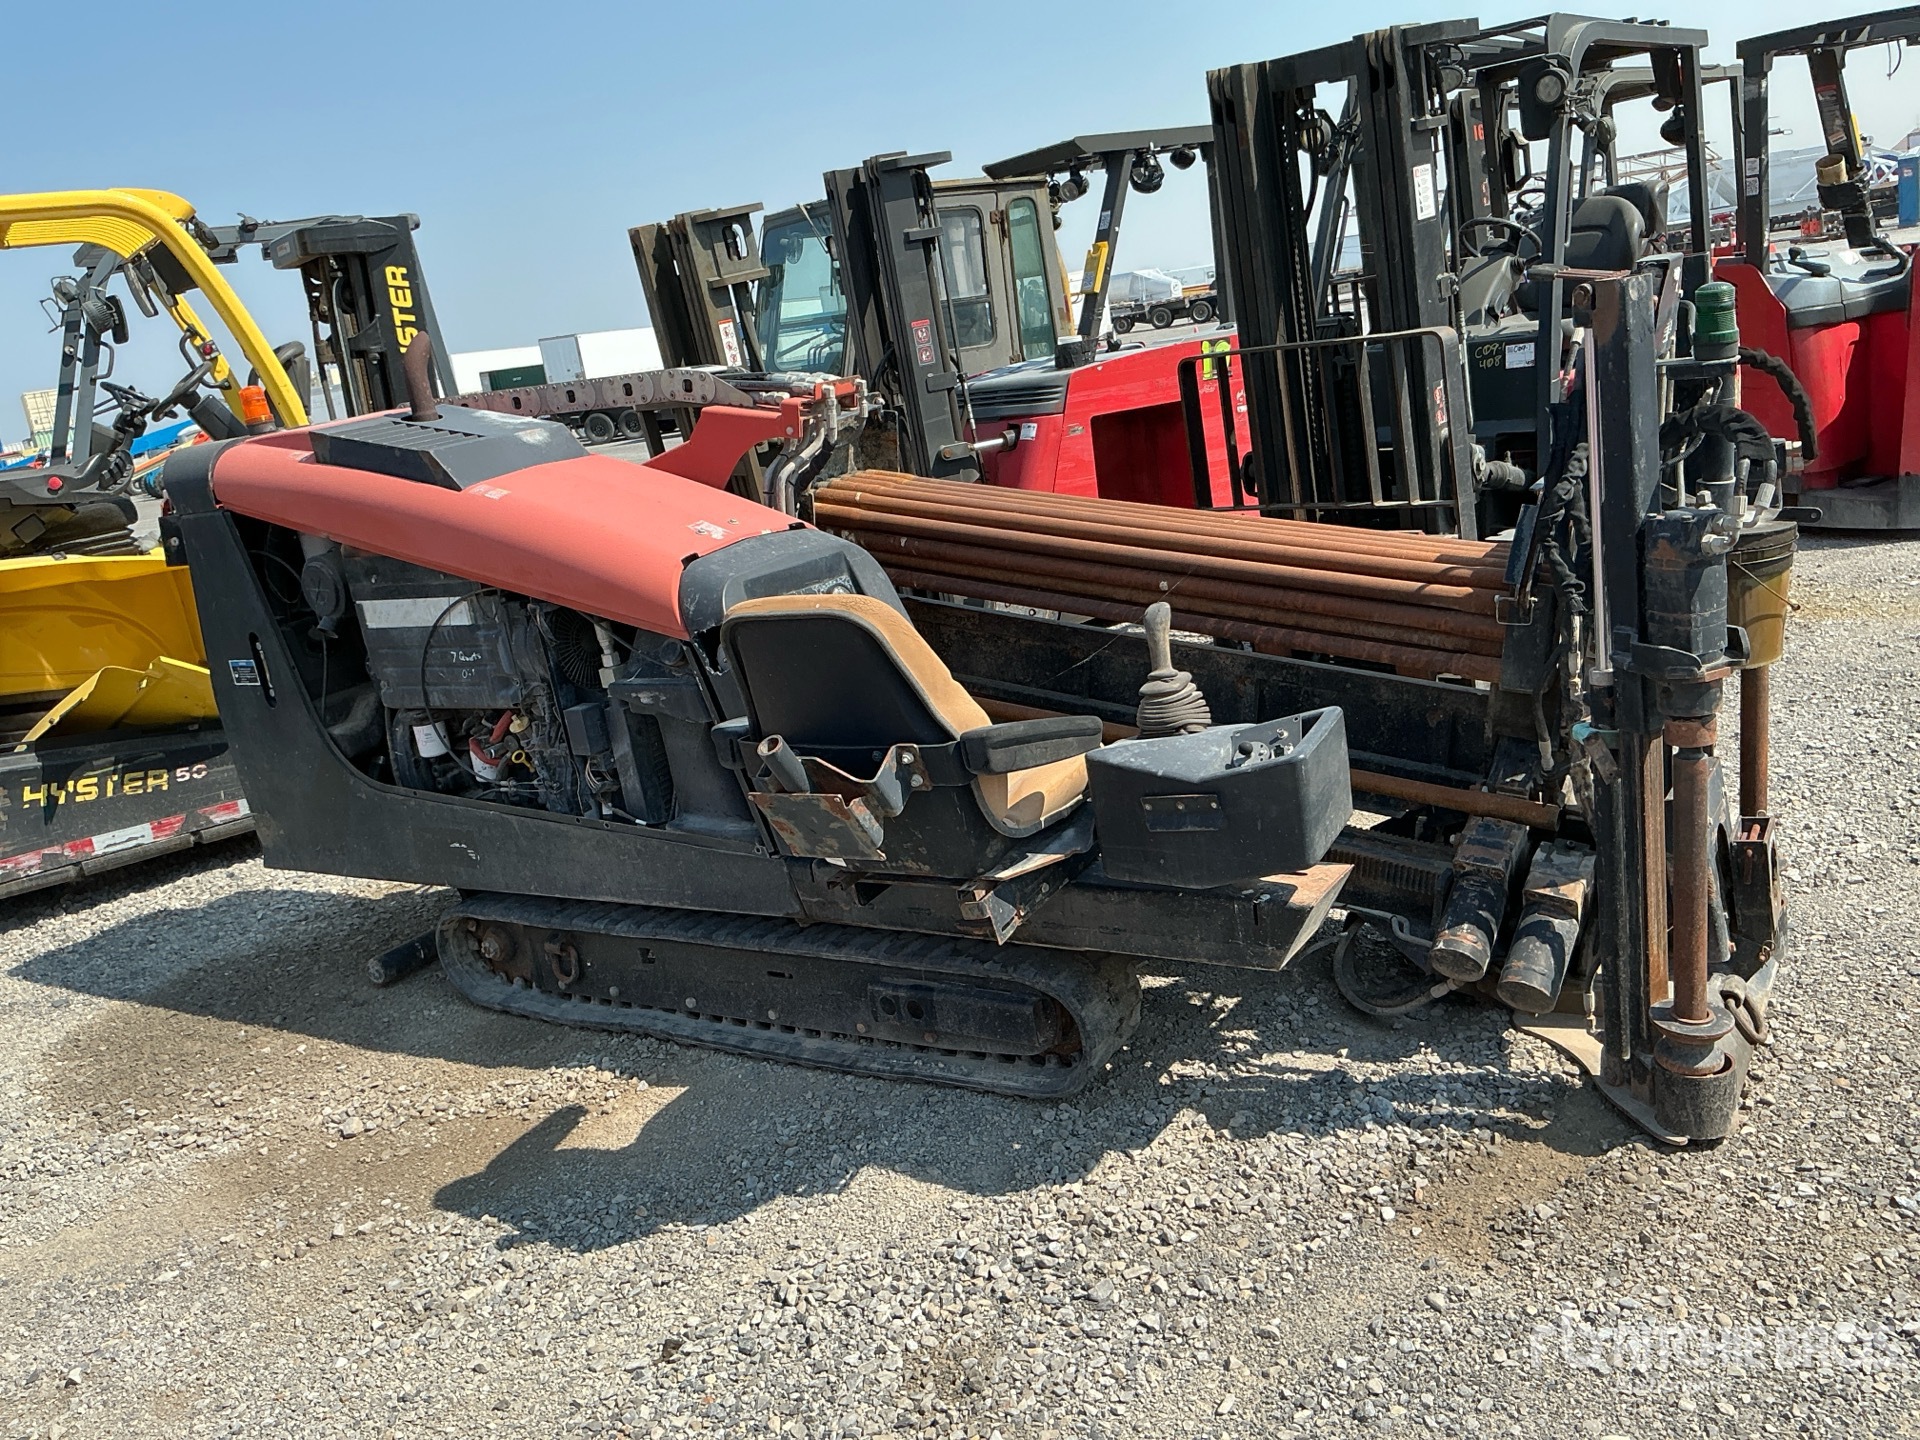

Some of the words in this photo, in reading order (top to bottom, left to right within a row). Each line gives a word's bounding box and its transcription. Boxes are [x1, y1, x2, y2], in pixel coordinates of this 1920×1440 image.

[384, 265, 419, 354] STER
[1479, 354, 1503, 370] 408
[22, 768, 170, 810] HYSTER
